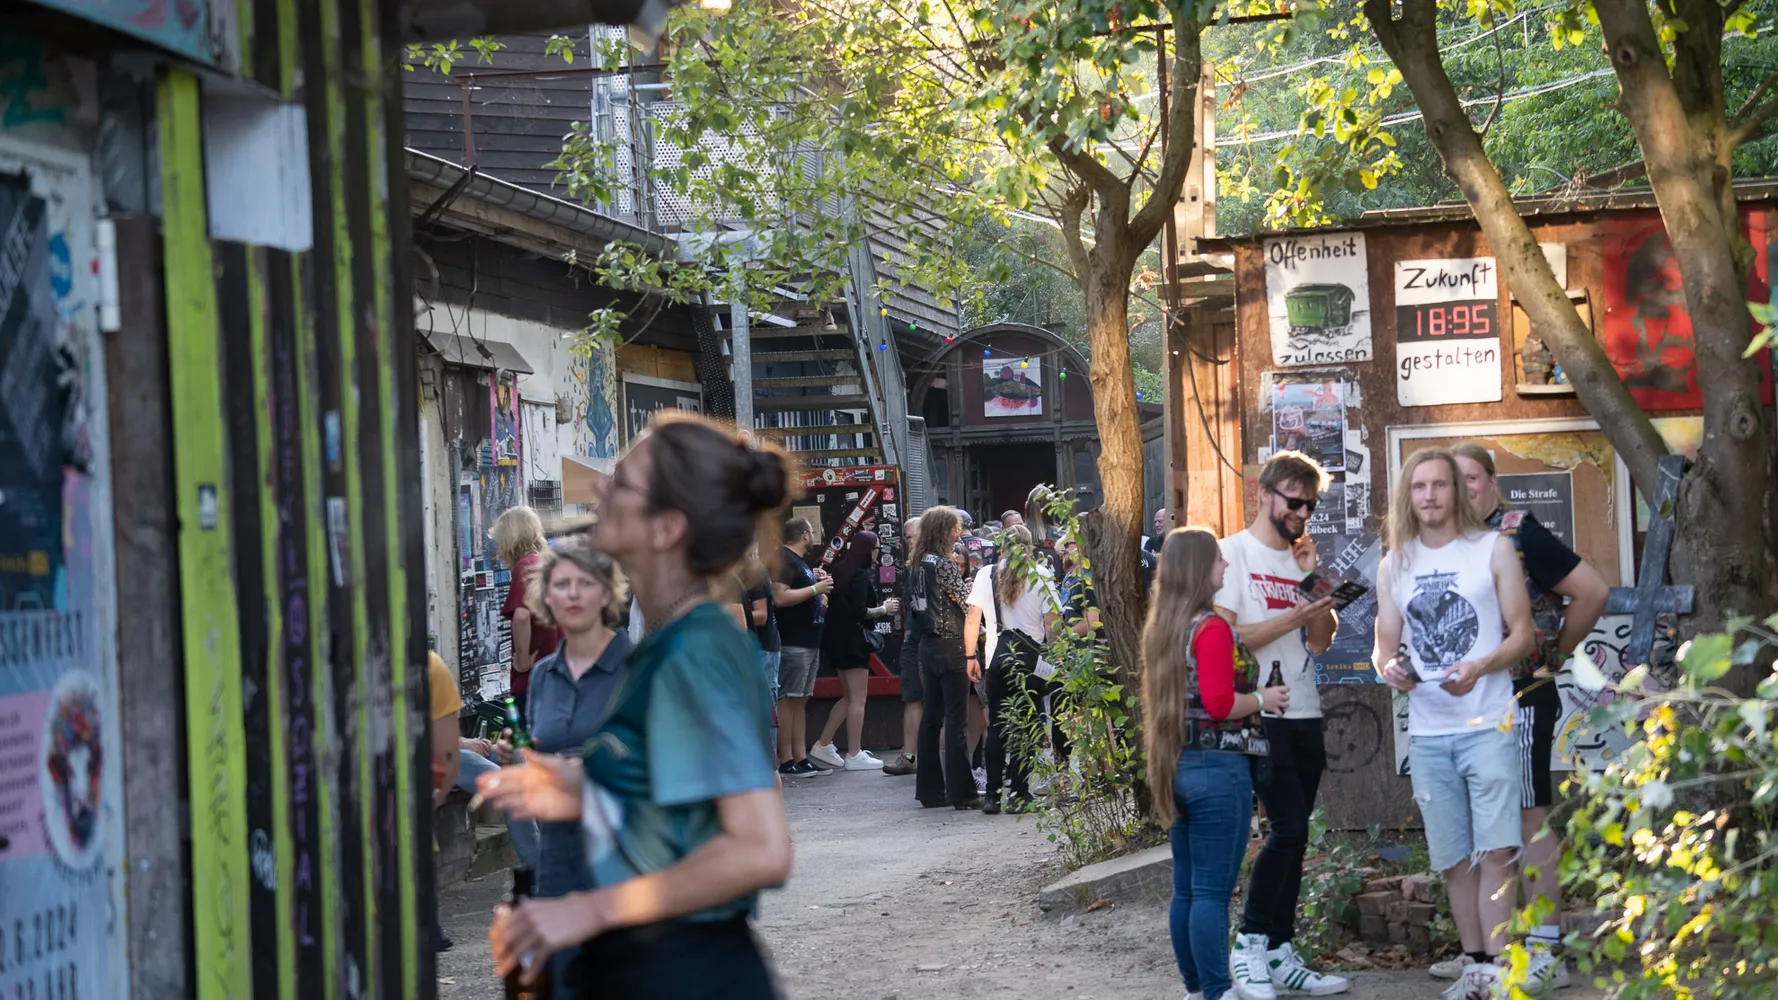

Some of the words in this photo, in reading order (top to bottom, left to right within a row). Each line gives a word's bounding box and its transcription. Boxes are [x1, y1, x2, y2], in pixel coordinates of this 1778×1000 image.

[1270, 237, 1357, 270] Offenheit
[1402, 262, 1492, 296] Zukunft
[1416, 304, 1490, 336] 18:95
[1279, 348, 1367, 364] zulassen
[1400, 346, 1495, 381] gestalten
[1510, 489, 1527, 499] Die
[1528, 488, 1558, 498] Strafe
